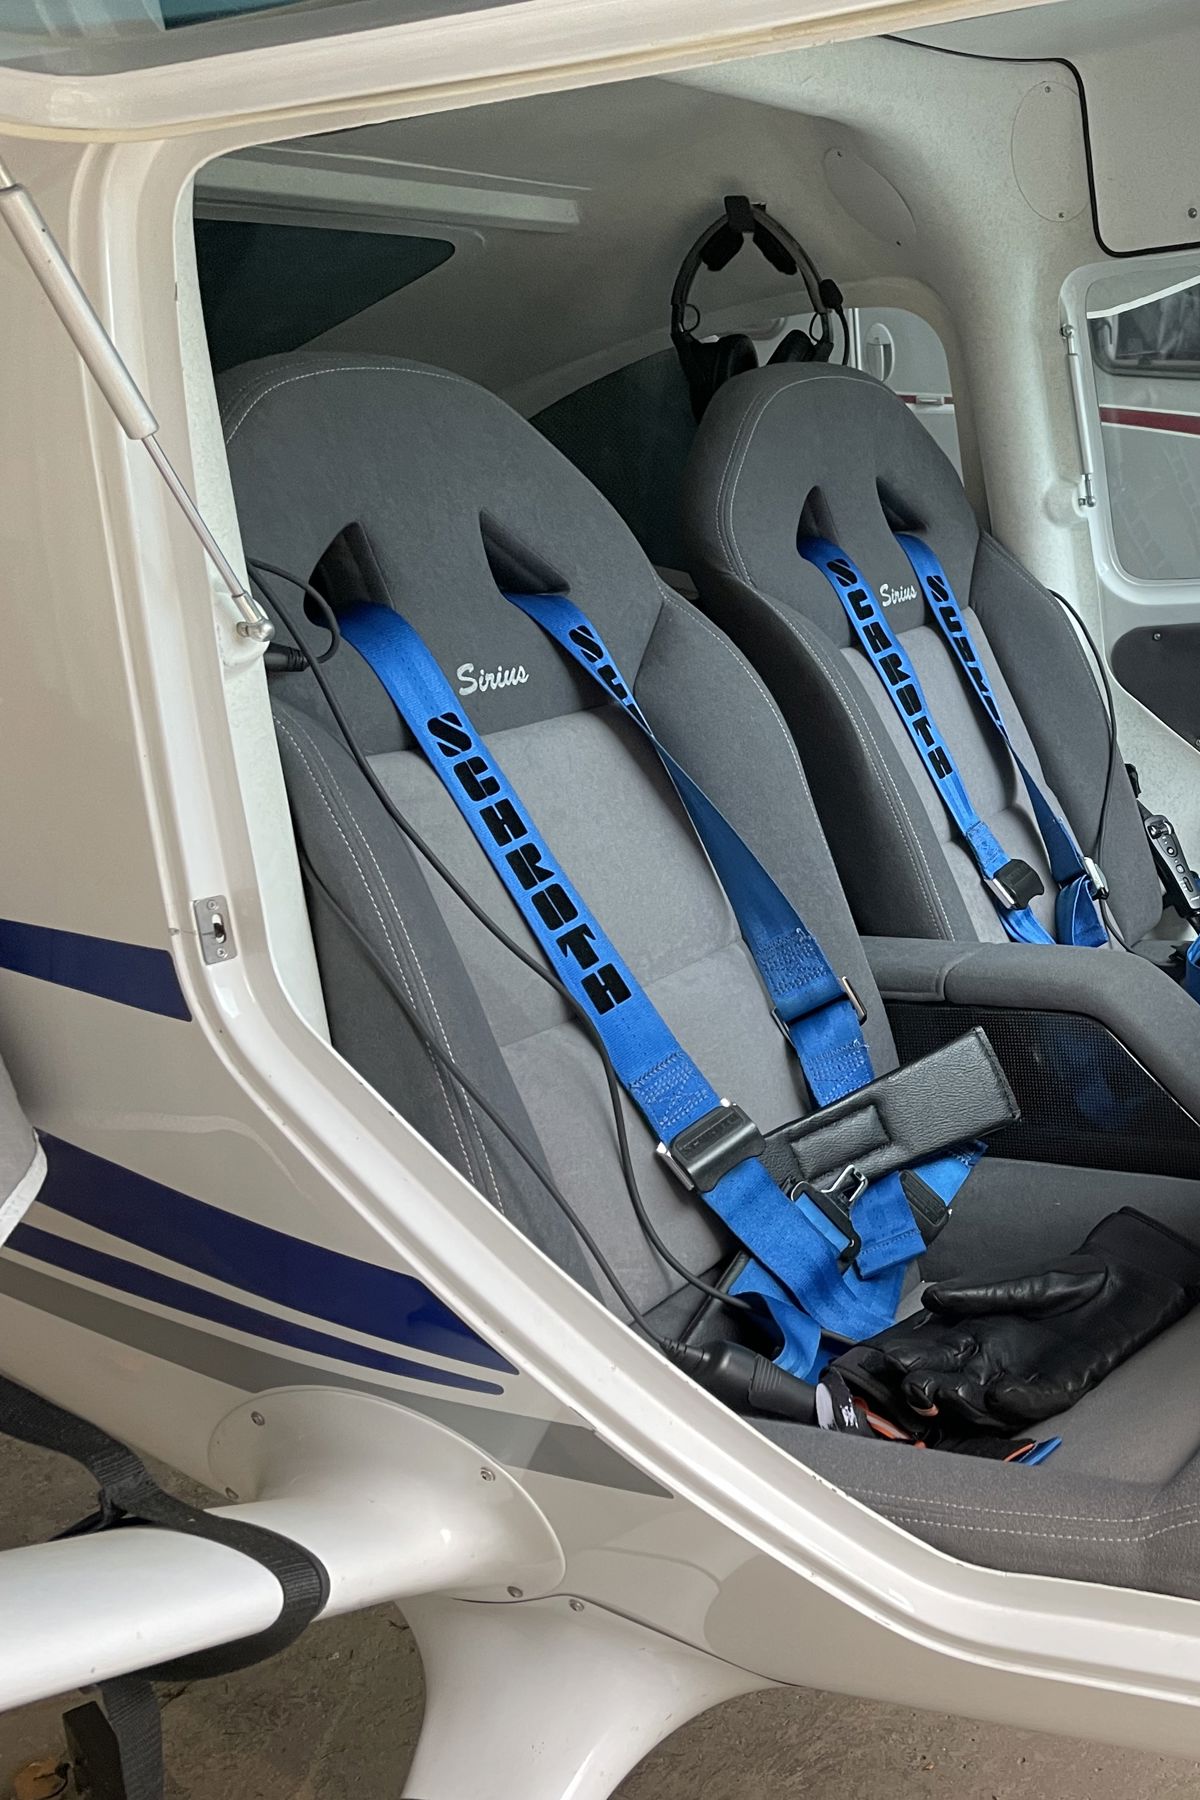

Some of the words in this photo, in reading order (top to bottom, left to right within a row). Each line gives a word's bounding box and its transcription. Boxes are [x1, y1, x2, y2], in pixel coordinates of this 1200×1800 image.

[879, 583, 918, 607] Sirius
[456, 662, 530, 696] Sirius
[826, 558, 954, 780] SCHROTH
[426, 711, 633, 1016] SCHROTH
